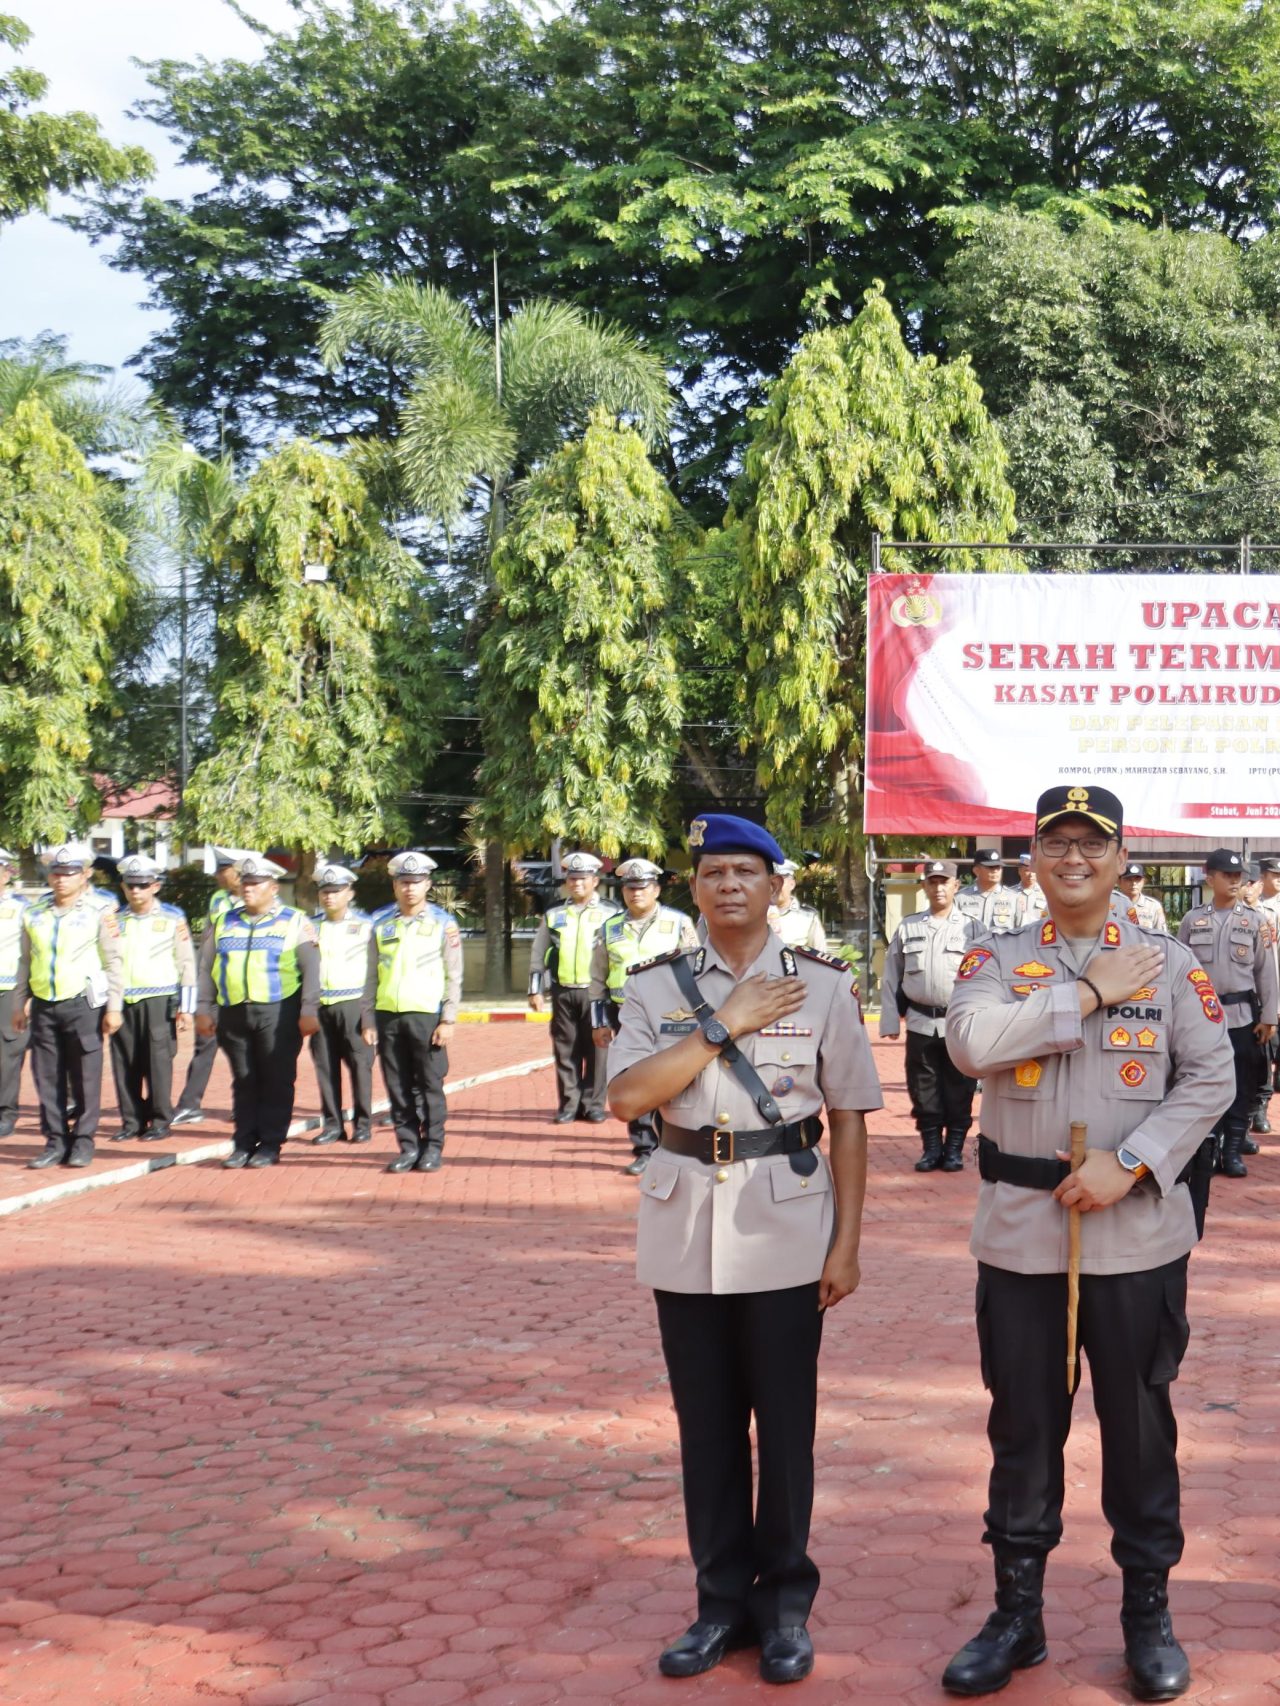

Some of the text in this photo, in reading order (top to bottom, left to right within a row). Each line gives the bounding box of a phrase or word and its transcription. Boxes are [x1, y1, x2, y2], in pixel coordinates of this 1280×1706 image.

[962, 641, 1117, 672] SERAH
[993, 683, 1100, 705] KASAT
[1069, 715, 1120, 731] DAN
[1126, 715, 1269, 732] PELEPASAN
[1078, 736, 1209, 753] PERSONEL
[1058, 767, 1092, 775] KOMPOL
[1094, 767, 1123, 775] (PURN.)
[1210, 805, 1240, 817] Stabat,
[1245, 805, 1263, 816] Juni
[1232, 927, 1255, 935] POLRI
[1107, 1006, 1162, 1021] POLRI
